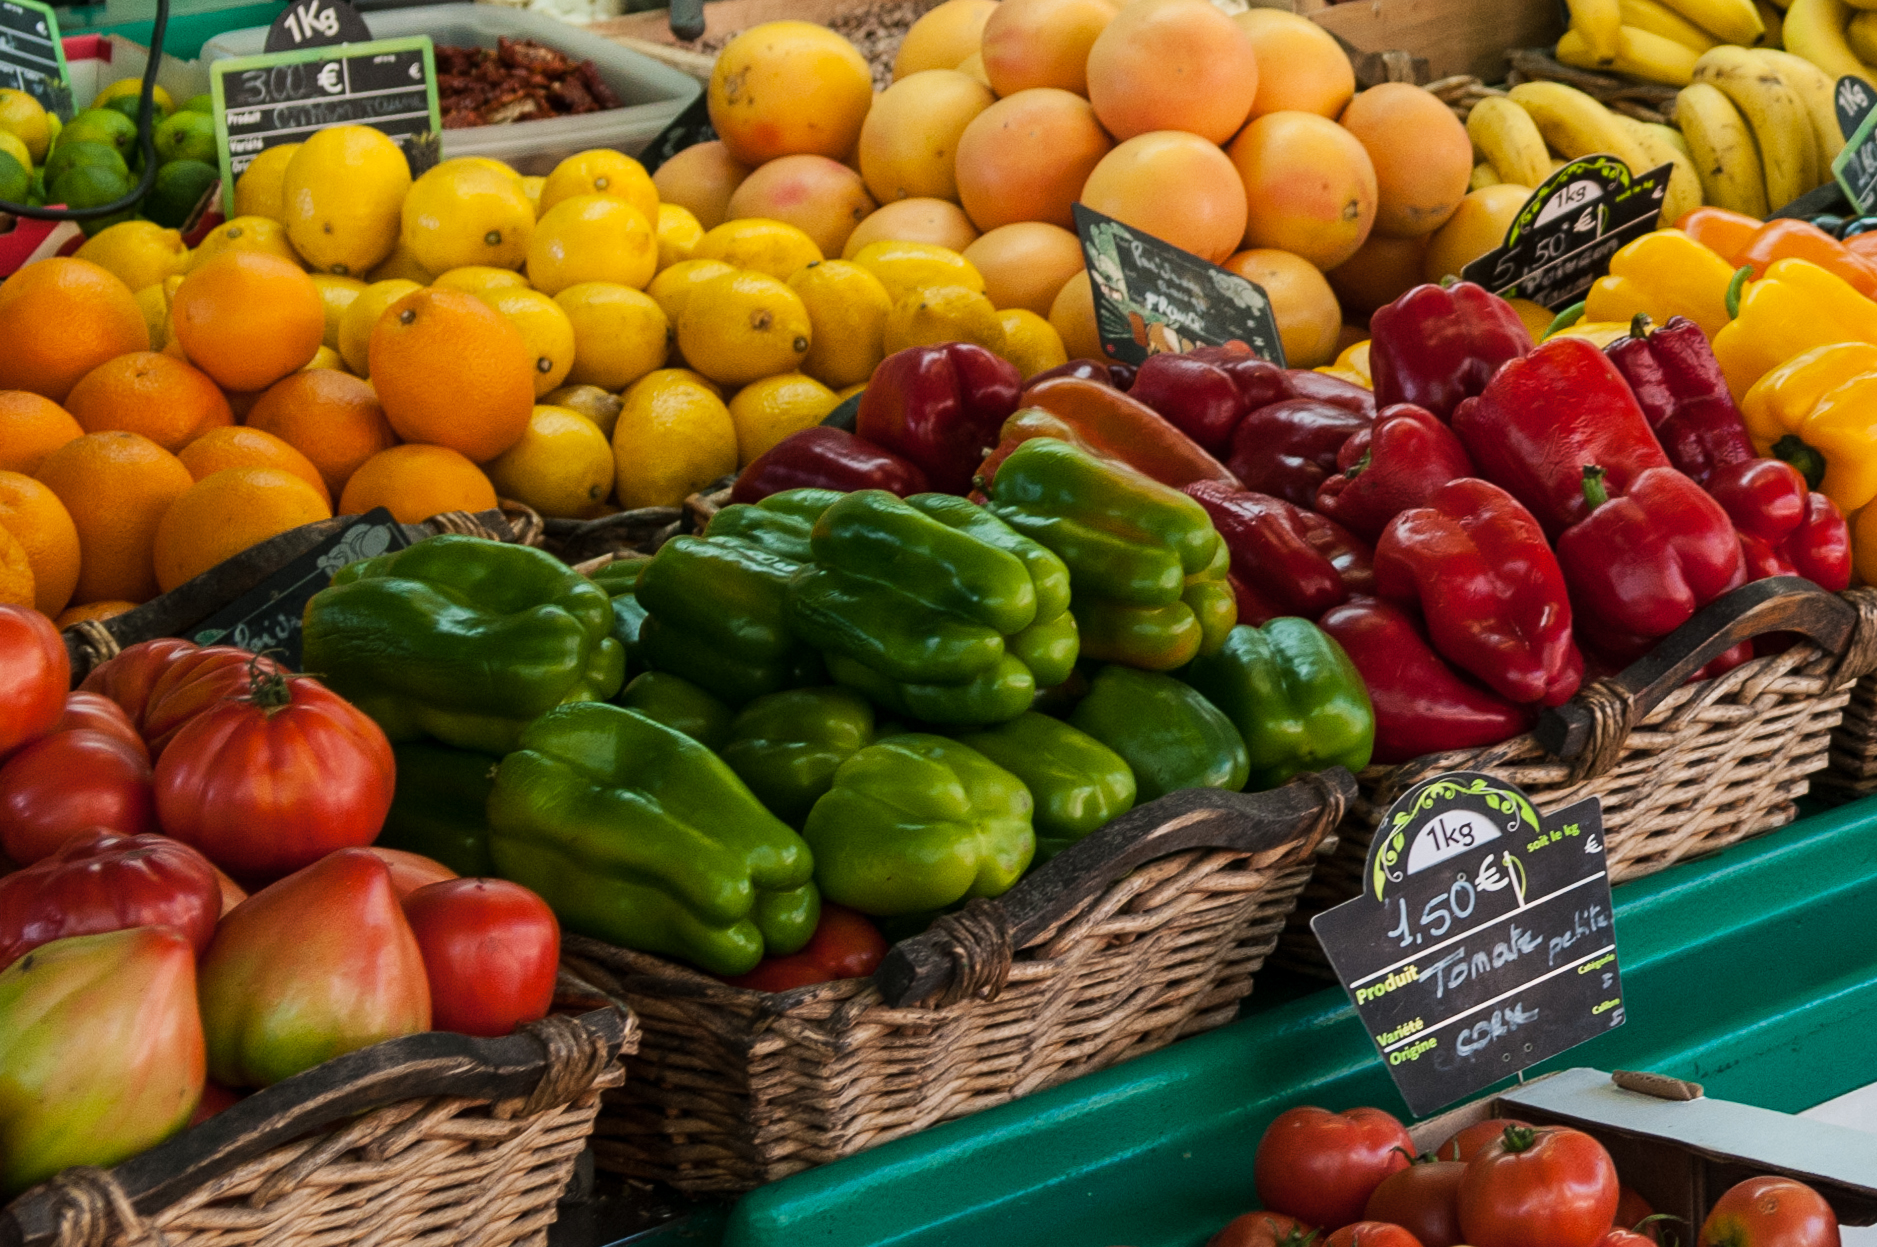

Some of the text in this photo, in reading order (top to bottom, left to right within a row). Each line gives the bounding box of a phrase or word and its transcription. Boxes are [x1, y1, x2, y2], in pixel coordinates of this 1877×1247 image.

[284, 0, 340, 44] 1Kg
[317, 62, 344, 94] €
[1838, 78, 1869, 117] 1Kg
[1554, 185, 1587, 208] 1kg
[1424, 818, 1475, 853] 1kg
[1527, 823, 1580, 853] soit le kg
[1584, 833, 1603, 854] €
[1355, 963, 1420, 1006] Produit
[1376, 1016, 1425, 1048] Variété
[1389, 1036, 1438, 1066] Origine
